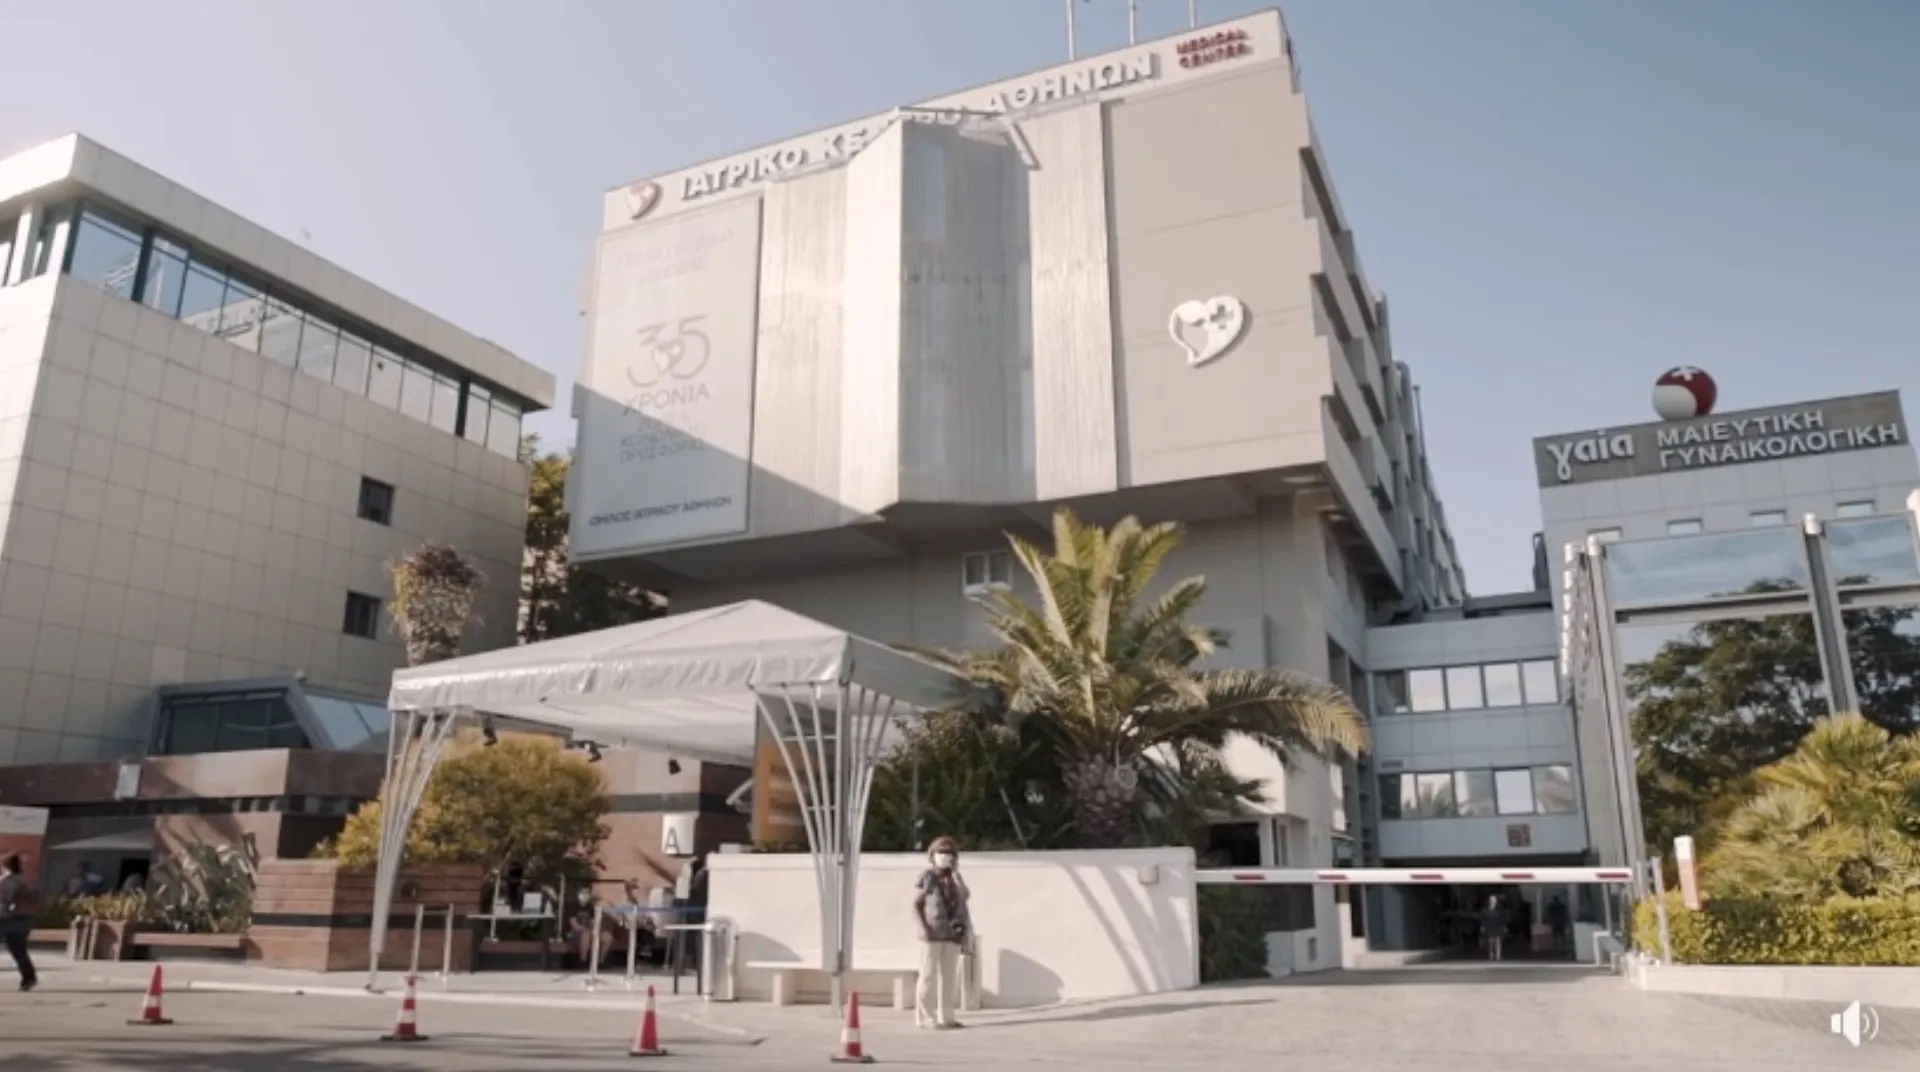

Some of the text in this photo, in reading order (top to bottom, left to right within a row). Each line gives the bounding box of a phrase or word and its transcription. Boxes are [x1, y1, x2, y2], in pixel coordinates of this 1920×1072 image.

[1176, 28, 1248, 54] MEDICAL
[1179, 43, 1252, 69] CENTER
[681, 147, 808, 201] ΙΑΤΡΙΚΟ
[985, 52, 1160, 114] ΑΘΗΝΩΝ
[622, 382, 711, 416] ΧΡΟΝΙΑ
[1657, 409, 1824, 448] ΜΑΙΕΥΤΙΚΗ
[1659, 422, 1899, 469] ΓΥΝΑΙΚΟΛΟΓΙΚΗ
